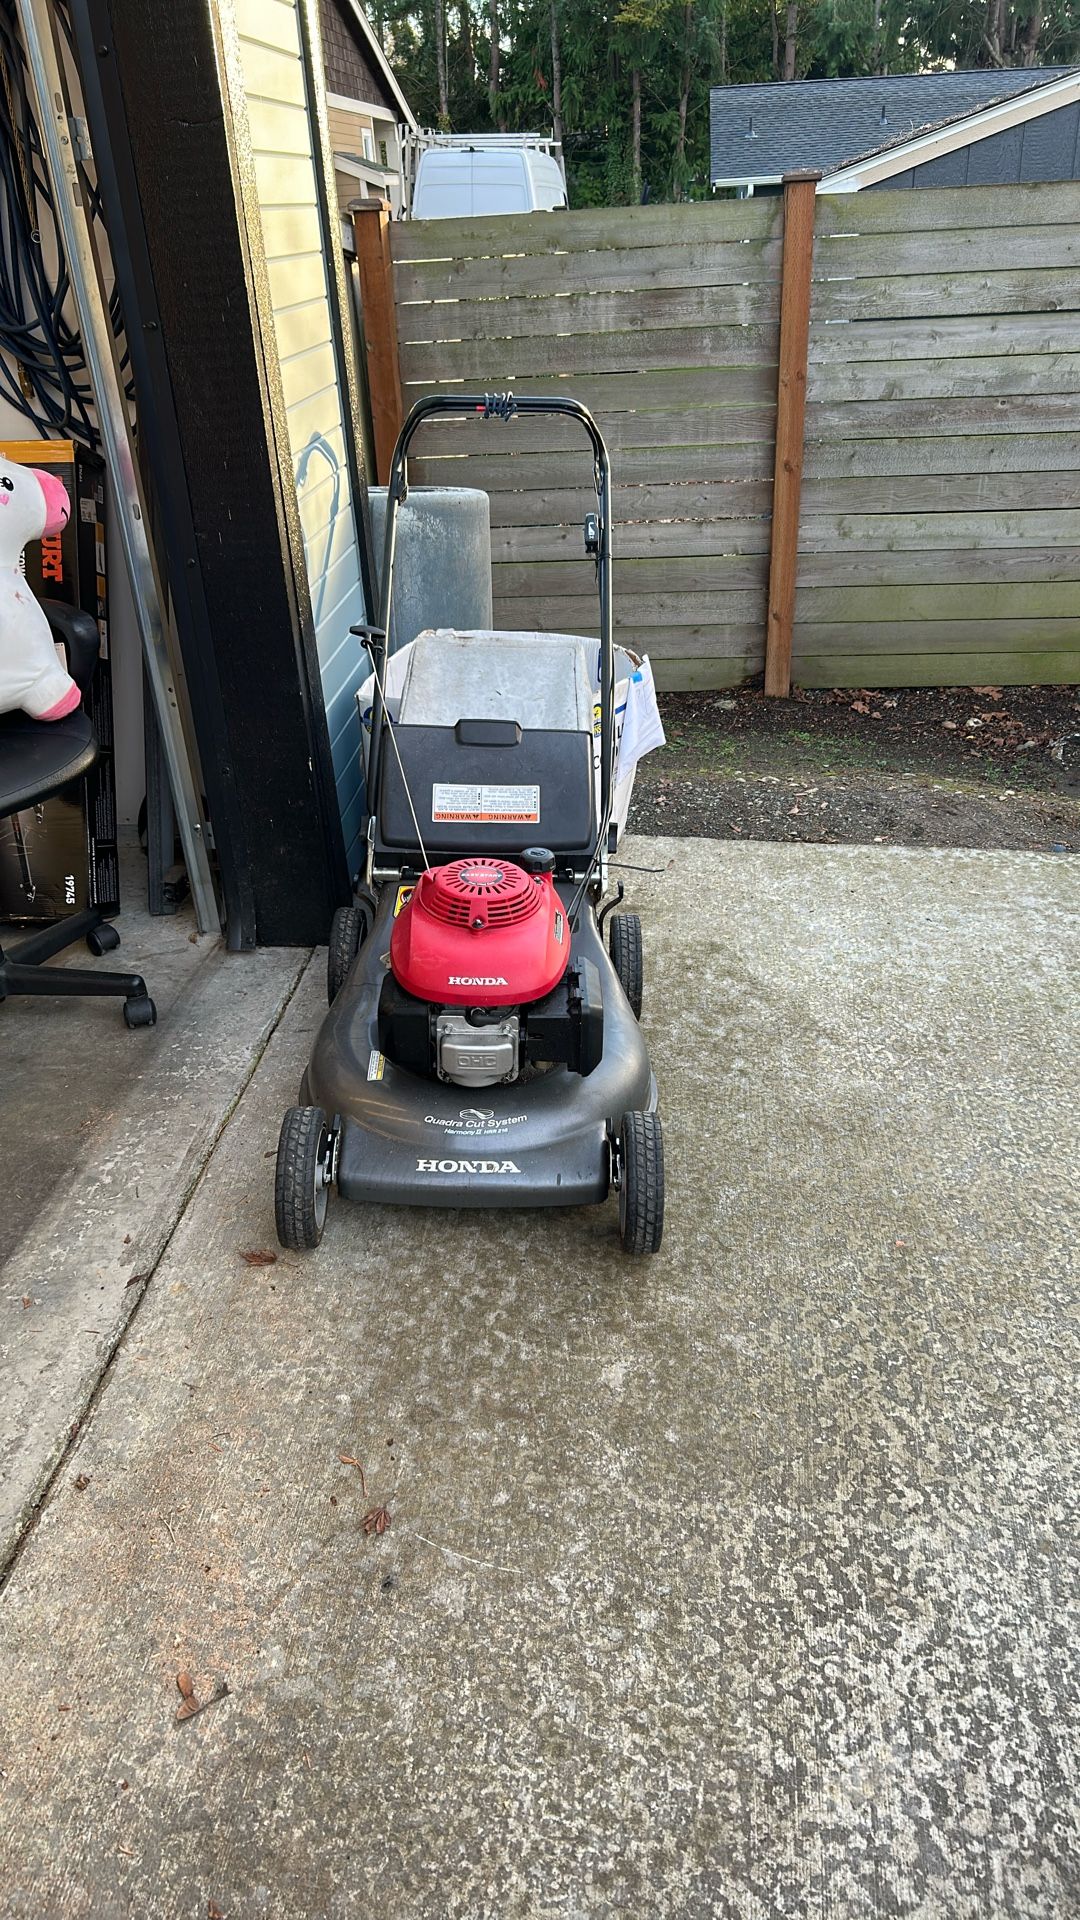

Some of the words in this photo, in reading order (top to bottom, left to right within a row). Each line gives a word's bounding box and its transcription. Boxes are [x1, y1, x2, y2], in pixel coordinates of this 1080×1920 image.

[64, 874, 76, 905] 19745
[448, 976, 508, 986] HONDA
[458, 1055, 496, 1066] OHC
[424, 1115, 463, 1128] Quadra
[466, 1120, 486, 1128] Cut
[487, 1115, 528, 1128] System
[444, 1128, 475, 1136] Harmony
[415, 1159, 521, 1173] HONDA
